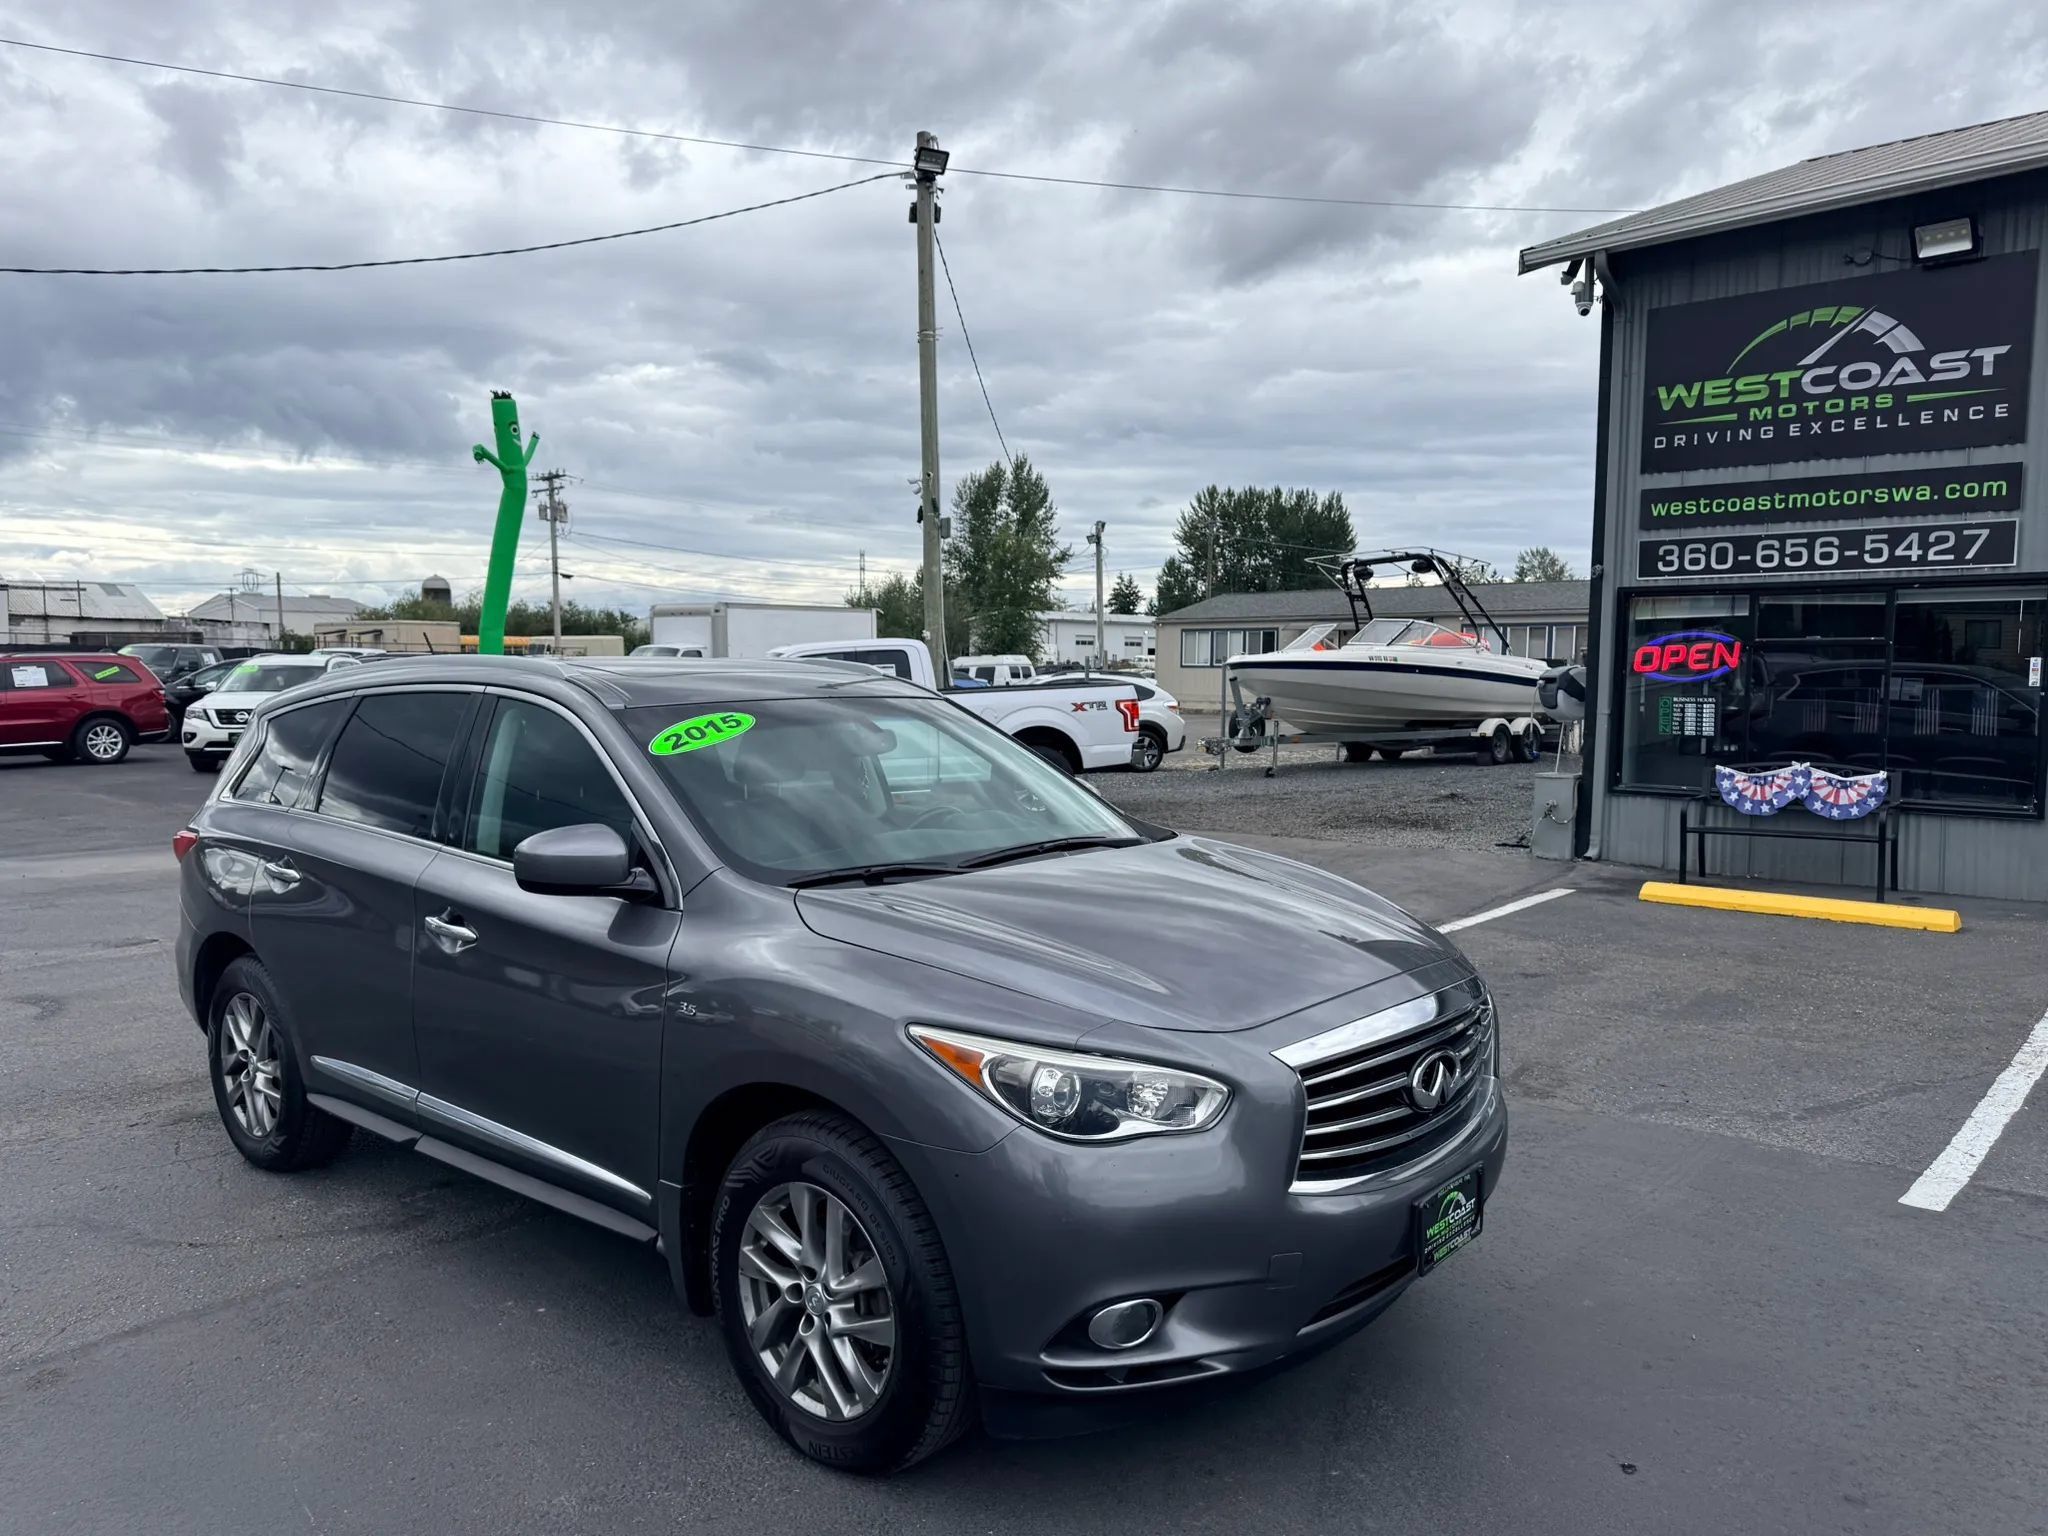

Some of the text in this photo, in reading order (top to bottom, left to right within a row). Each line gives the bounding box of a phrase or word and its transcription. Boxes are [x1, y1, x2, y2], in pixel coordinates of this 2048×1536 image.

[1657, 345, 2012, 412] WESTCOAST
[1654, 403, 2008, 449] DRIVING EXCELLENCE
[1749, 394, 1893, 421] MOTORS
[1651, 479, 2008, 517] westcoastmotorswa.com
[1657, 529, 1990, 573] 360-656-5427
[1633, 640, 1743, 673] OPEN
[663, 714, 742, 751] 2015
[867, 1207, 897, 1266] DESIGN
[1426, 1198, 1476, 1239] WESTCOAST
